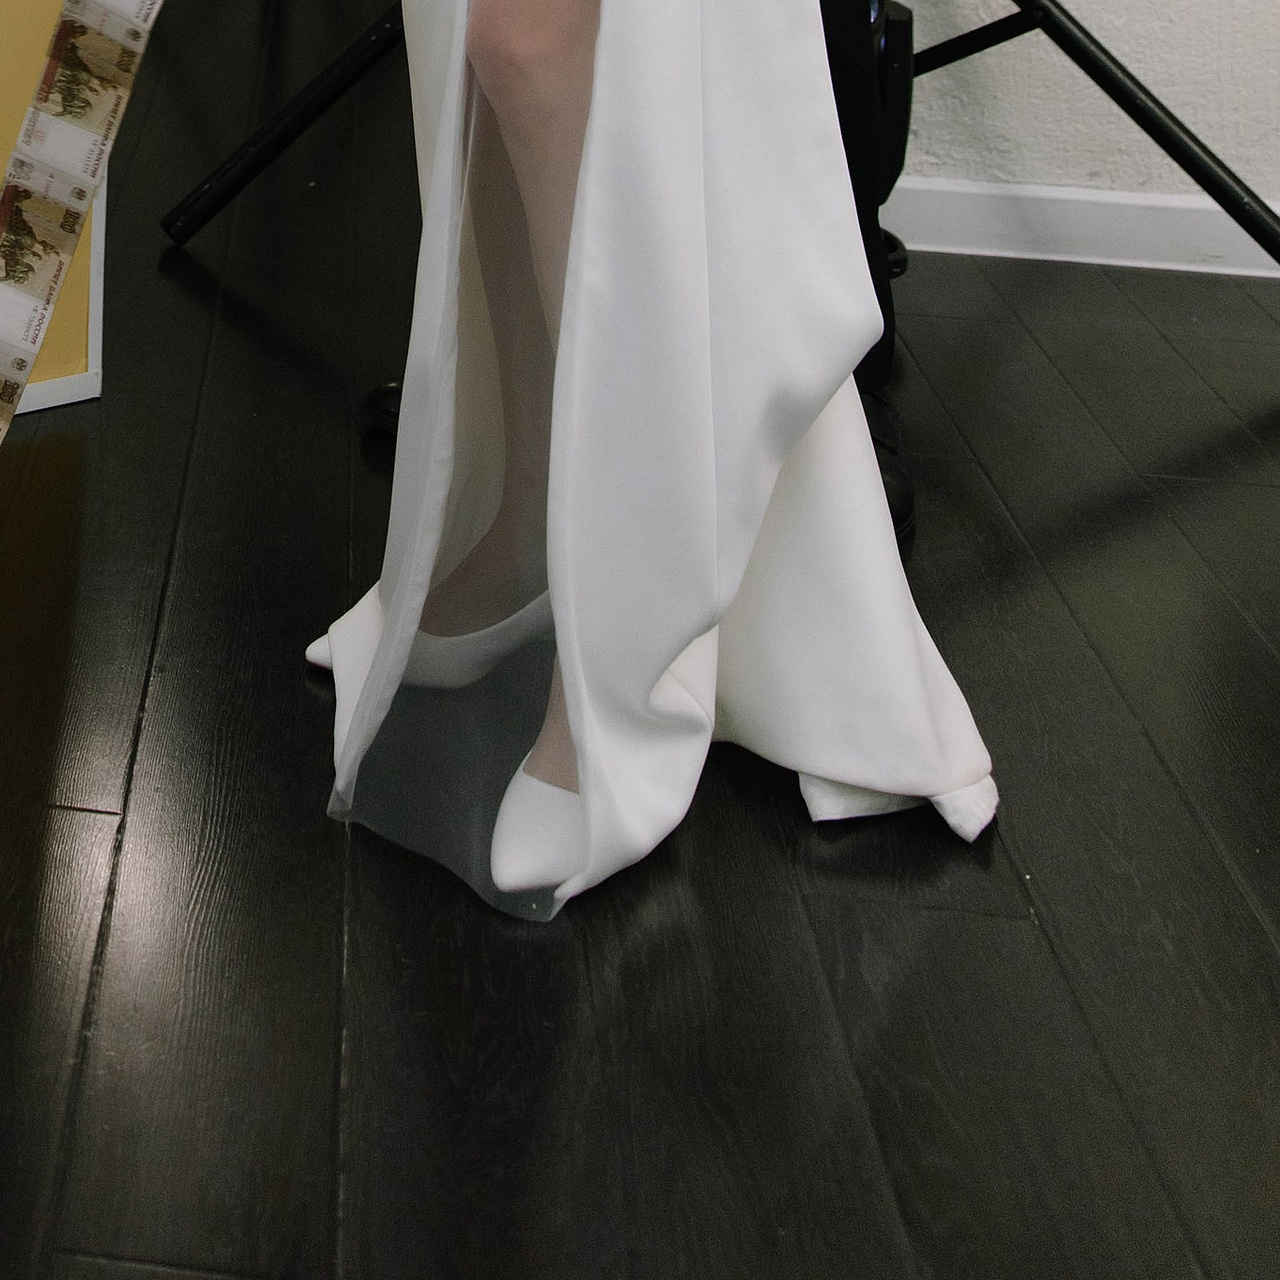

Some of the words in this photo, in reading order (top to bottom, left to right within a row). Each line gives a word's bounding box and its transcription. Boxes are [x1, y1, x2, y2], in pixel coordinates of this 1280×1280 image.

[60, 207, 82, 235] 100
[51, 259, 64, 285] БИЛЕТ
[41, 284, 56, 311] БАНКА
[30, 311, 46, 345] РОССИИ
[0, 378, 20, 406] 100
